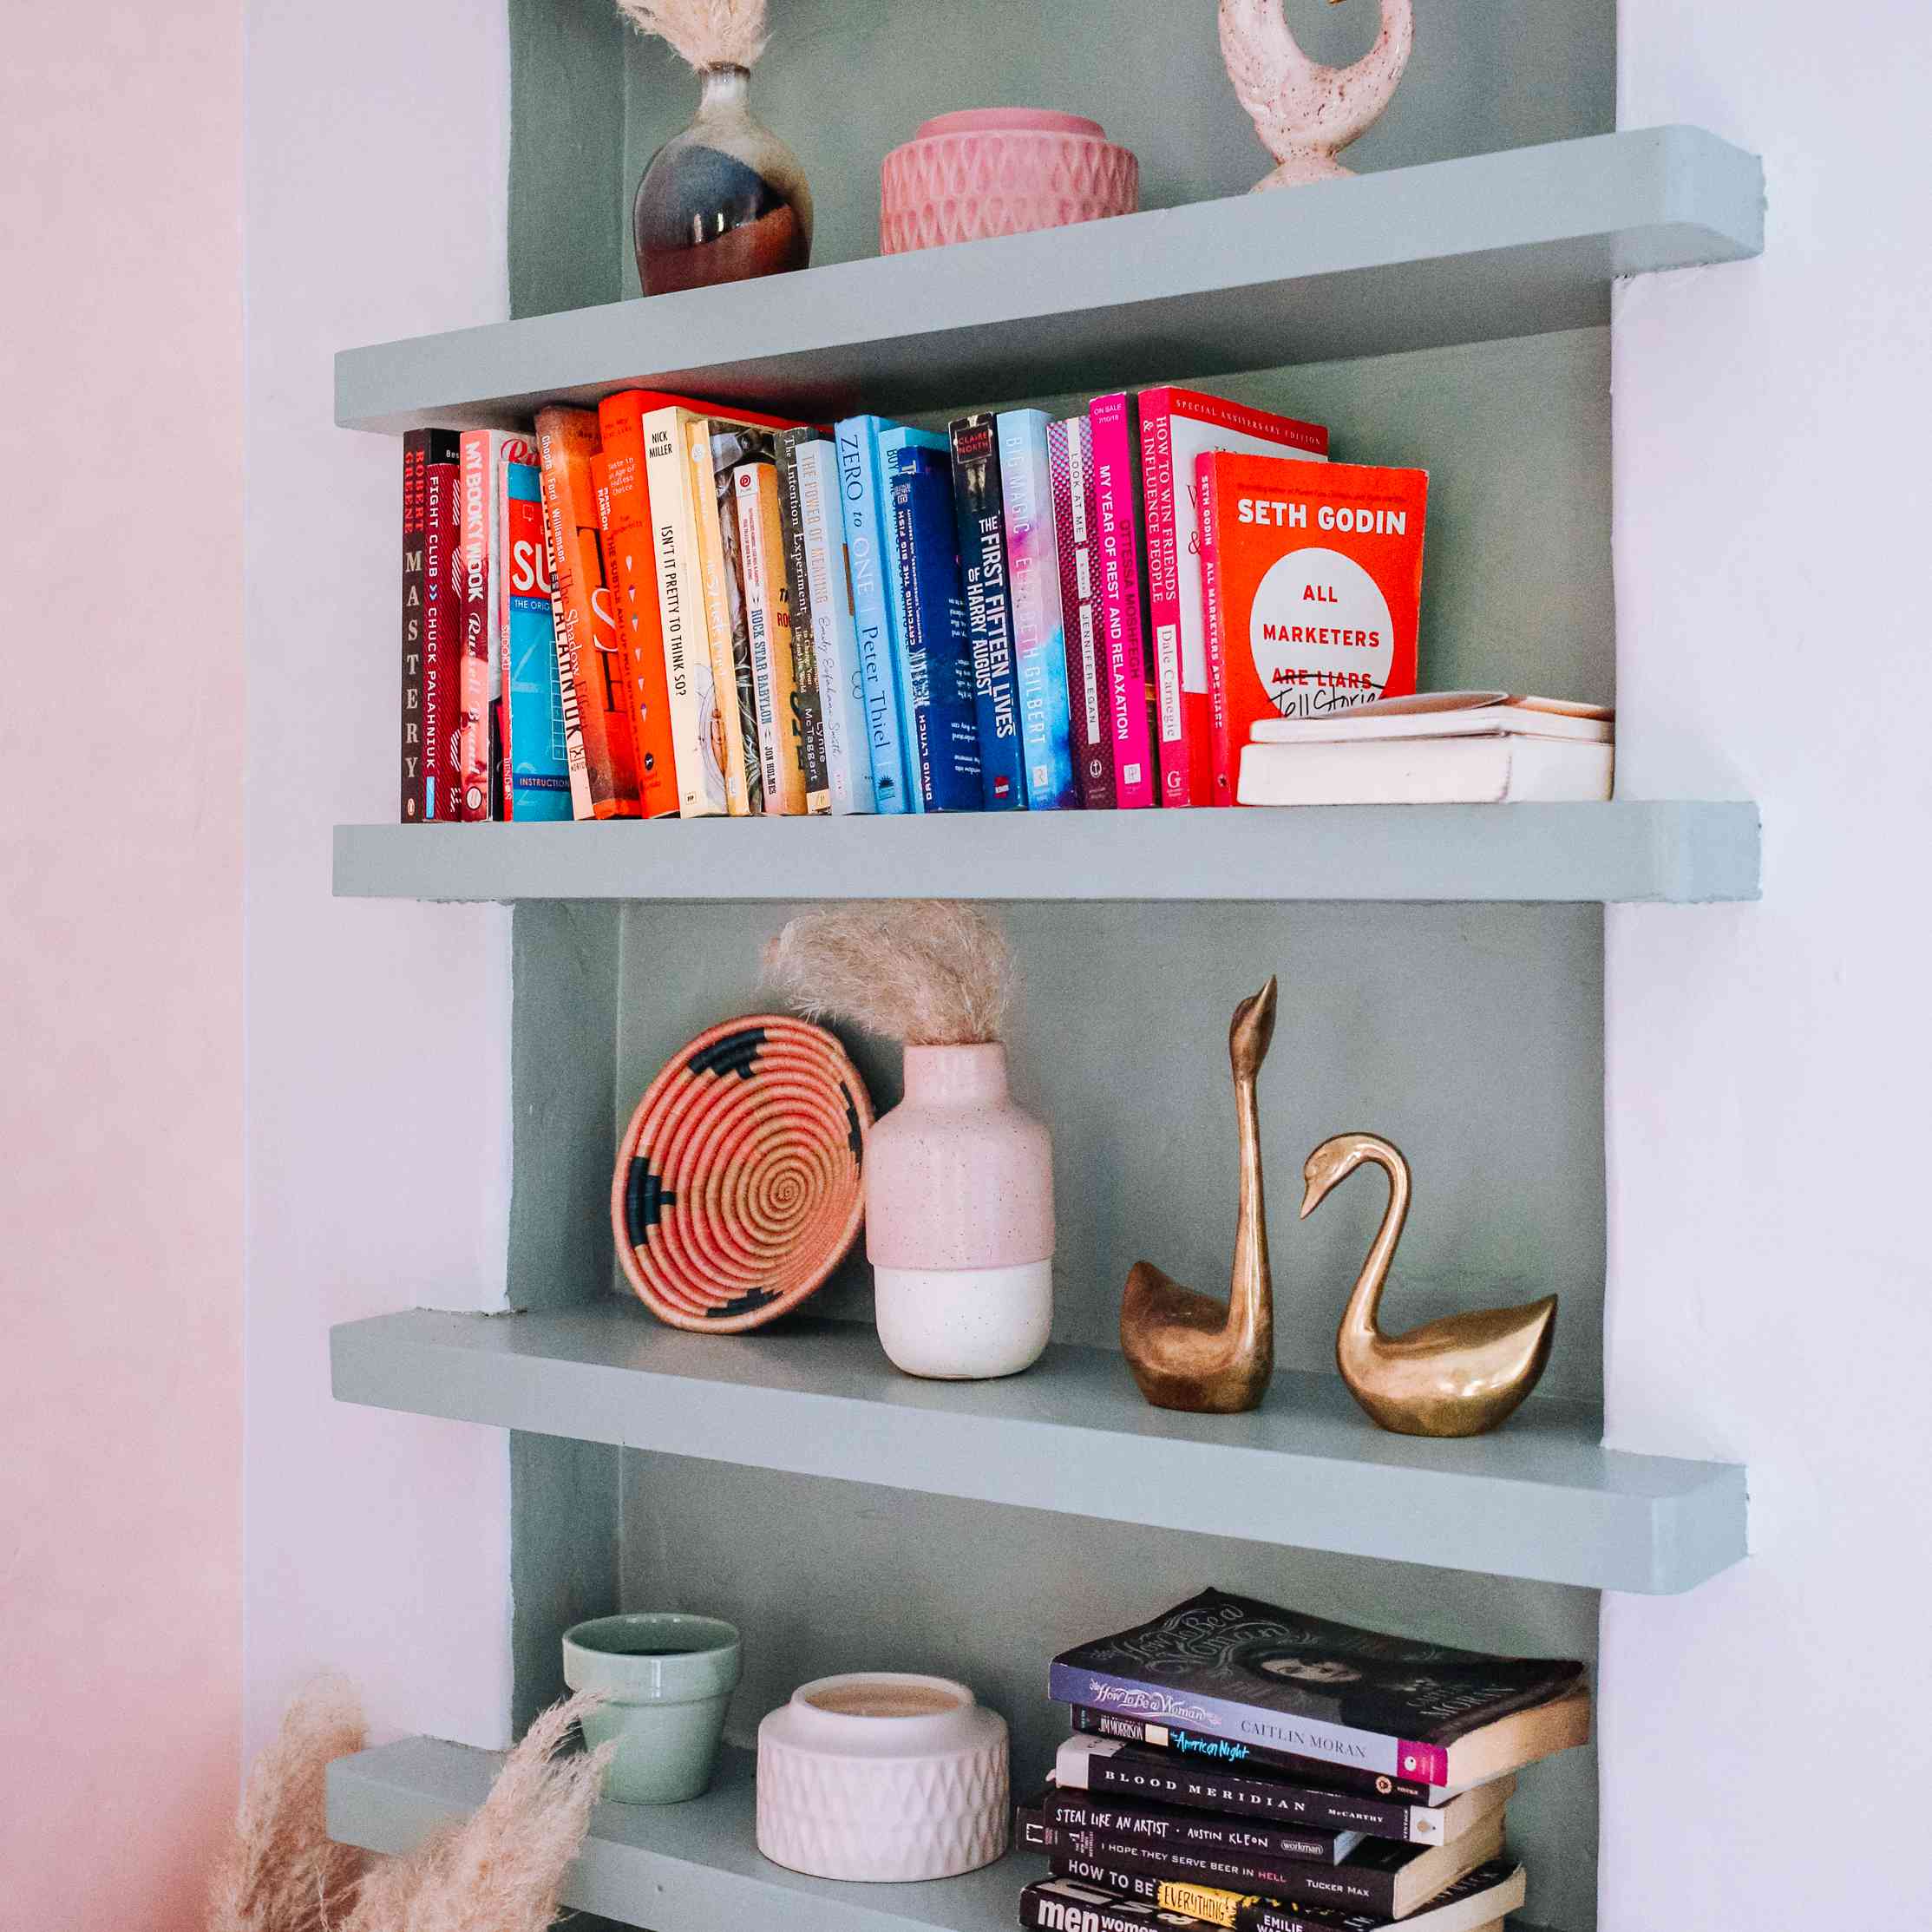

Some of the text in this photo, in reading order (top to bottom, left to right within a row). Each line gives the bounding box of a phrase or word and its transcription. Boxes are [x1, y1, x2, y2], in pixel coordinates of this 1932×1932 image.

[1104, 403, 1122, 413] SALE
[1176, 399, 1320, 445] SPECIAL ANNIVERSARY EDITION
[649, 443, 673, 458] MILLER
[652, 430, 668, 443] NICK
[958, 430, 988, 446] CLAIRE
[958, 441, 989, 455] NORTH
[416, 449, 425, 532] ROBERT
[802, 454, 816, 478] THE
[1005, 436, 1031, 535] BIG MAGIC
[404, 451, 414, 534] GREENE
[540, 435, 553, 471] Chopra
[547, 477, 556, 501] Ford
[552, 508, 566, 563] Williamson
[803, 481, 821, 525] POWER
[841, 434, 874, 595] ZERO to ONE
[1071, 453, 1084, 534] LOOK AT ME
[1143, 420, 1163, 603] & INFLUENCE PEOPLE
[1156, 416, 1176, 601] HOW TO WIN FRIENDS
[1201, 475, 1212, 546] SETH GODIN
[1238, 499, 1406, 534] SETH GODIN
[465, 441, 485, 603] MY BOOKY WOOK
[607, 535, 616, 558] THE
[783, 436, 808, 614] The Intention Experiment
[808, 528, 823, 542] OF
[897, 510, 907, 537] FISH
[811, 547, 828, 605] MEANING
[900, 541, 908, 560] BIG
[1207, 563, 1215, 583] ALL
[514, 599, 528, 609] THE
[560, 567, 575, 606] The
[660, 525, 687, 697] ISN'T IT PRETTY TO THINK SO?
[1099, 464, 1129, 740] MY YEAR OF REST AND RELAXATION
[1303, 584, 1338, 603] ALL
[426, 476, 439, 769] FIGHT CLUB CHUCK PALAHNIUK
[566, 608, 583, 676] Shadow
[905, 590, 916, 646] CATCHING
[967, 567, 992, 696] OF HARRY AUGUST
[979, 515, 1014, 739] THE FIRST FIFTEEN LIVES
[1125, 593, 1140, 680] MOSHFEGH
[1207, 588, 1219, 660] MARKETERS
[1263, 623, 1380, 648] MARKETERS
[403, 550, 423, 778] MASTERY
[501, 625, 511, 671] SUDOKU
[750, 609, 772, 725] ROCK STAR BABYLON
[1081, 613, 1095, 681] JENNIFER
[861, 625, 891, 748] Peter Thiel
[1161, 630, 1176, 737] Dale Carnegie
[1270, 687, 1308, 717] Tell
[1272, 667, 1372, 690] ARE LIARS
[1025, 666, 1046, 743] GILBERT
[1085, 687, 1097, 724] EGAN
[803, 707, 819, 781] McTaggart
[815, 721, 826, 763] Lynne
[918, 714, 933, 801] DAVID LYNCH
[763, 746, 776, 796] JON HOLMES
[1095, 1683, 1126, 1702] How
[1134, 1693, 1149, 1709] Be
[1152, 1692, 1207, 1720] Woman
[1098, 1716, 1111, 1734] JIM
[1110, 1719, 1144, 1741] MORRISON
[1176, 1731, 1250, 1762] American Night
[1241, 1719, 1367, 1758] CAITLIN MORAN
[1104, 1770, 1385, 1824] BLOOD MERIDIAN McCARTHY
[1055, 1808, 1268, 1848] STEAL LIKE AN ARTIST AUSTIN KLEON
[1282, 1841, 1322, 1855] workman
[1068, 1859, 1225, 1922] HOW TO BE EVERYTHING
[1109, 1844, 1138, 1857] HOPE
[1141, 1849, 1169, 1861] THEY
[1171, 1855, 1207, 1869] SERVE
[1210, 1862, 1239, 1875] BEER
[1242, 1868, 1254, 1876] IN
[1257, 1870, 1287, 1883] HELL
[1306, 1879, 1344, 1893] TUCKER
[1346, 1886, 1370, 1896] MAX
[1038, 1899, 1098, 1932] men
[1263, 1914, 1304, 1932] EMILIE
